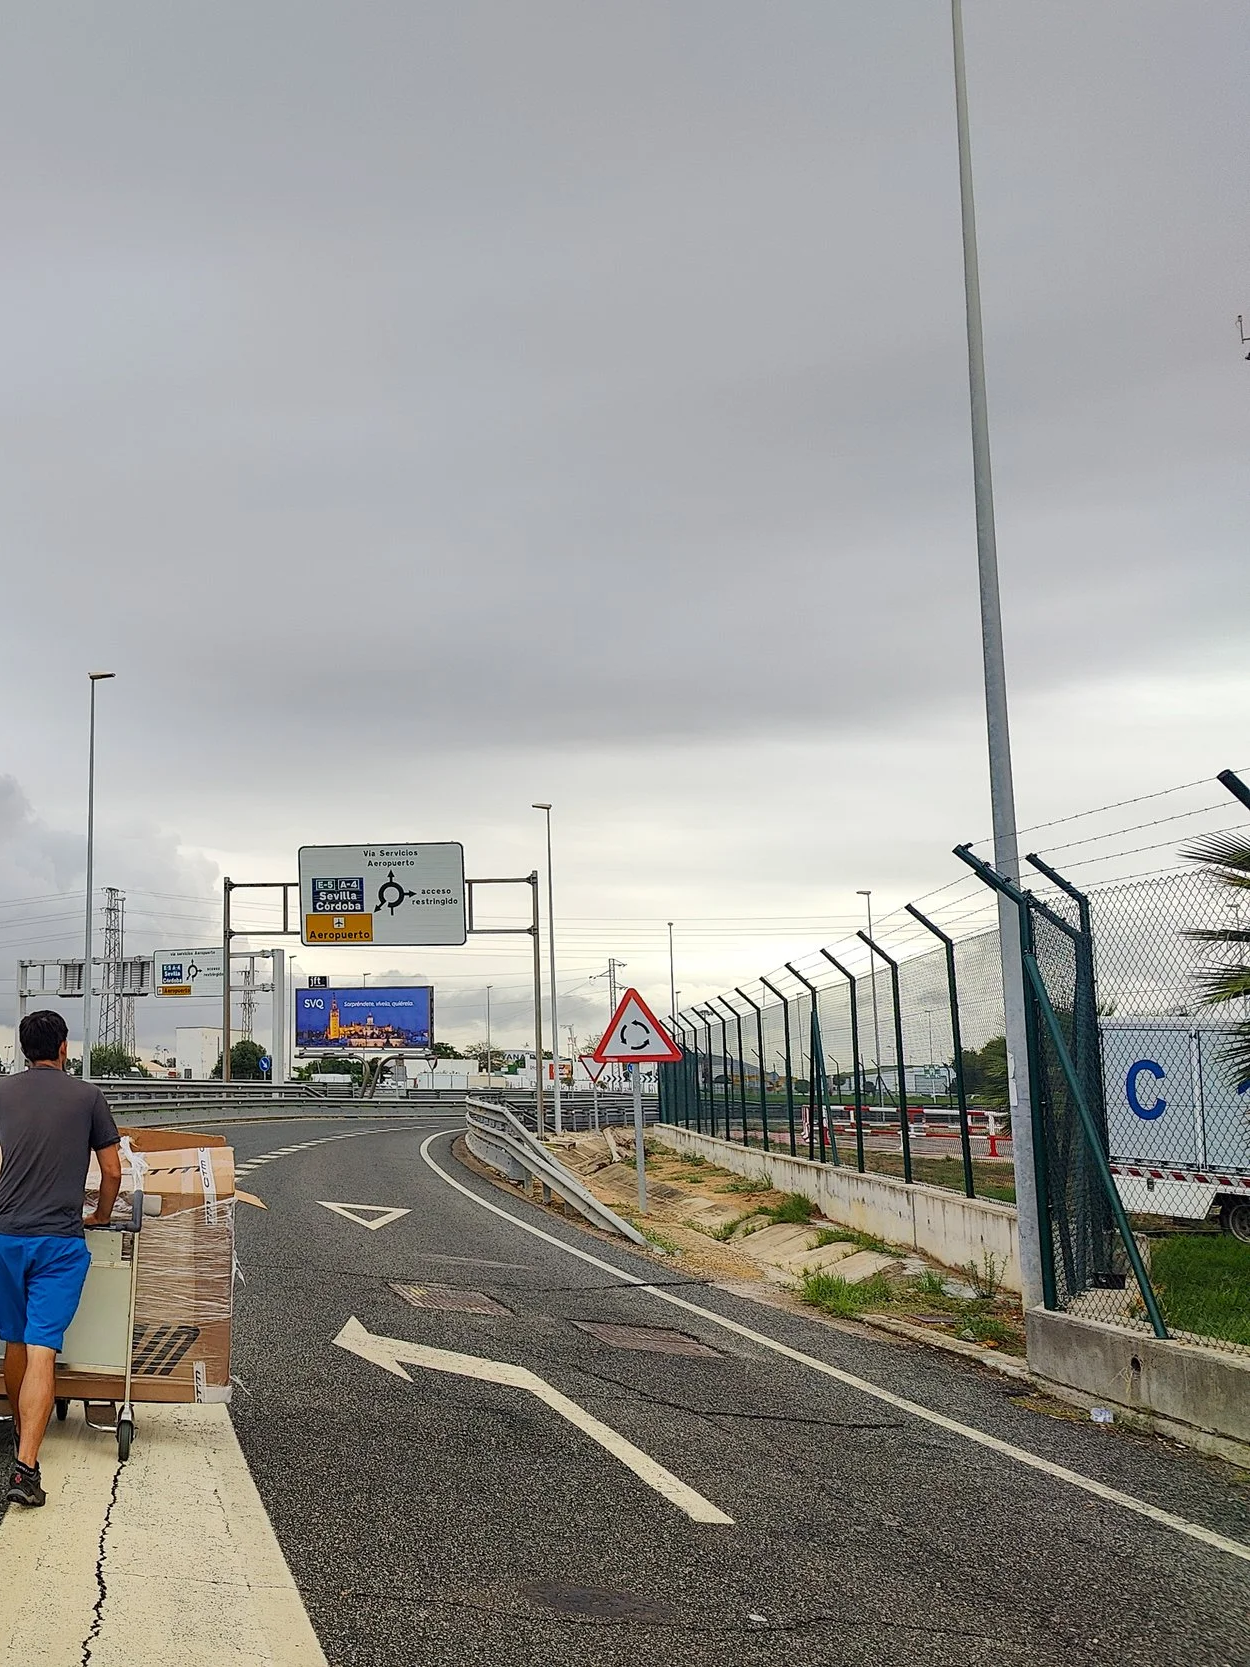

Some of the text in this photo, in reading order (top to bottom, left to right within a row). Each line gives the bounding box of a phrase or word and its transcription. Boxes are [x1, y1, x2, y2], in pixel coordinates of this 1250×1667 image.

[379, 849, 418, 857] Servicios
[367, 859, 415, 868] Aeropuerto
[317, 880, 358, 889] E-5 A-4
[319, 891, 357, 900] Sevilla
[316, 901, 361, 911] Córdoba
[411, 897, 458, 906] restringido
[309, 930, 371, 942] Aeropuerto
[304, 999, 324, 1009] SVQ
[1126, 1060, 1167, 1120] C
